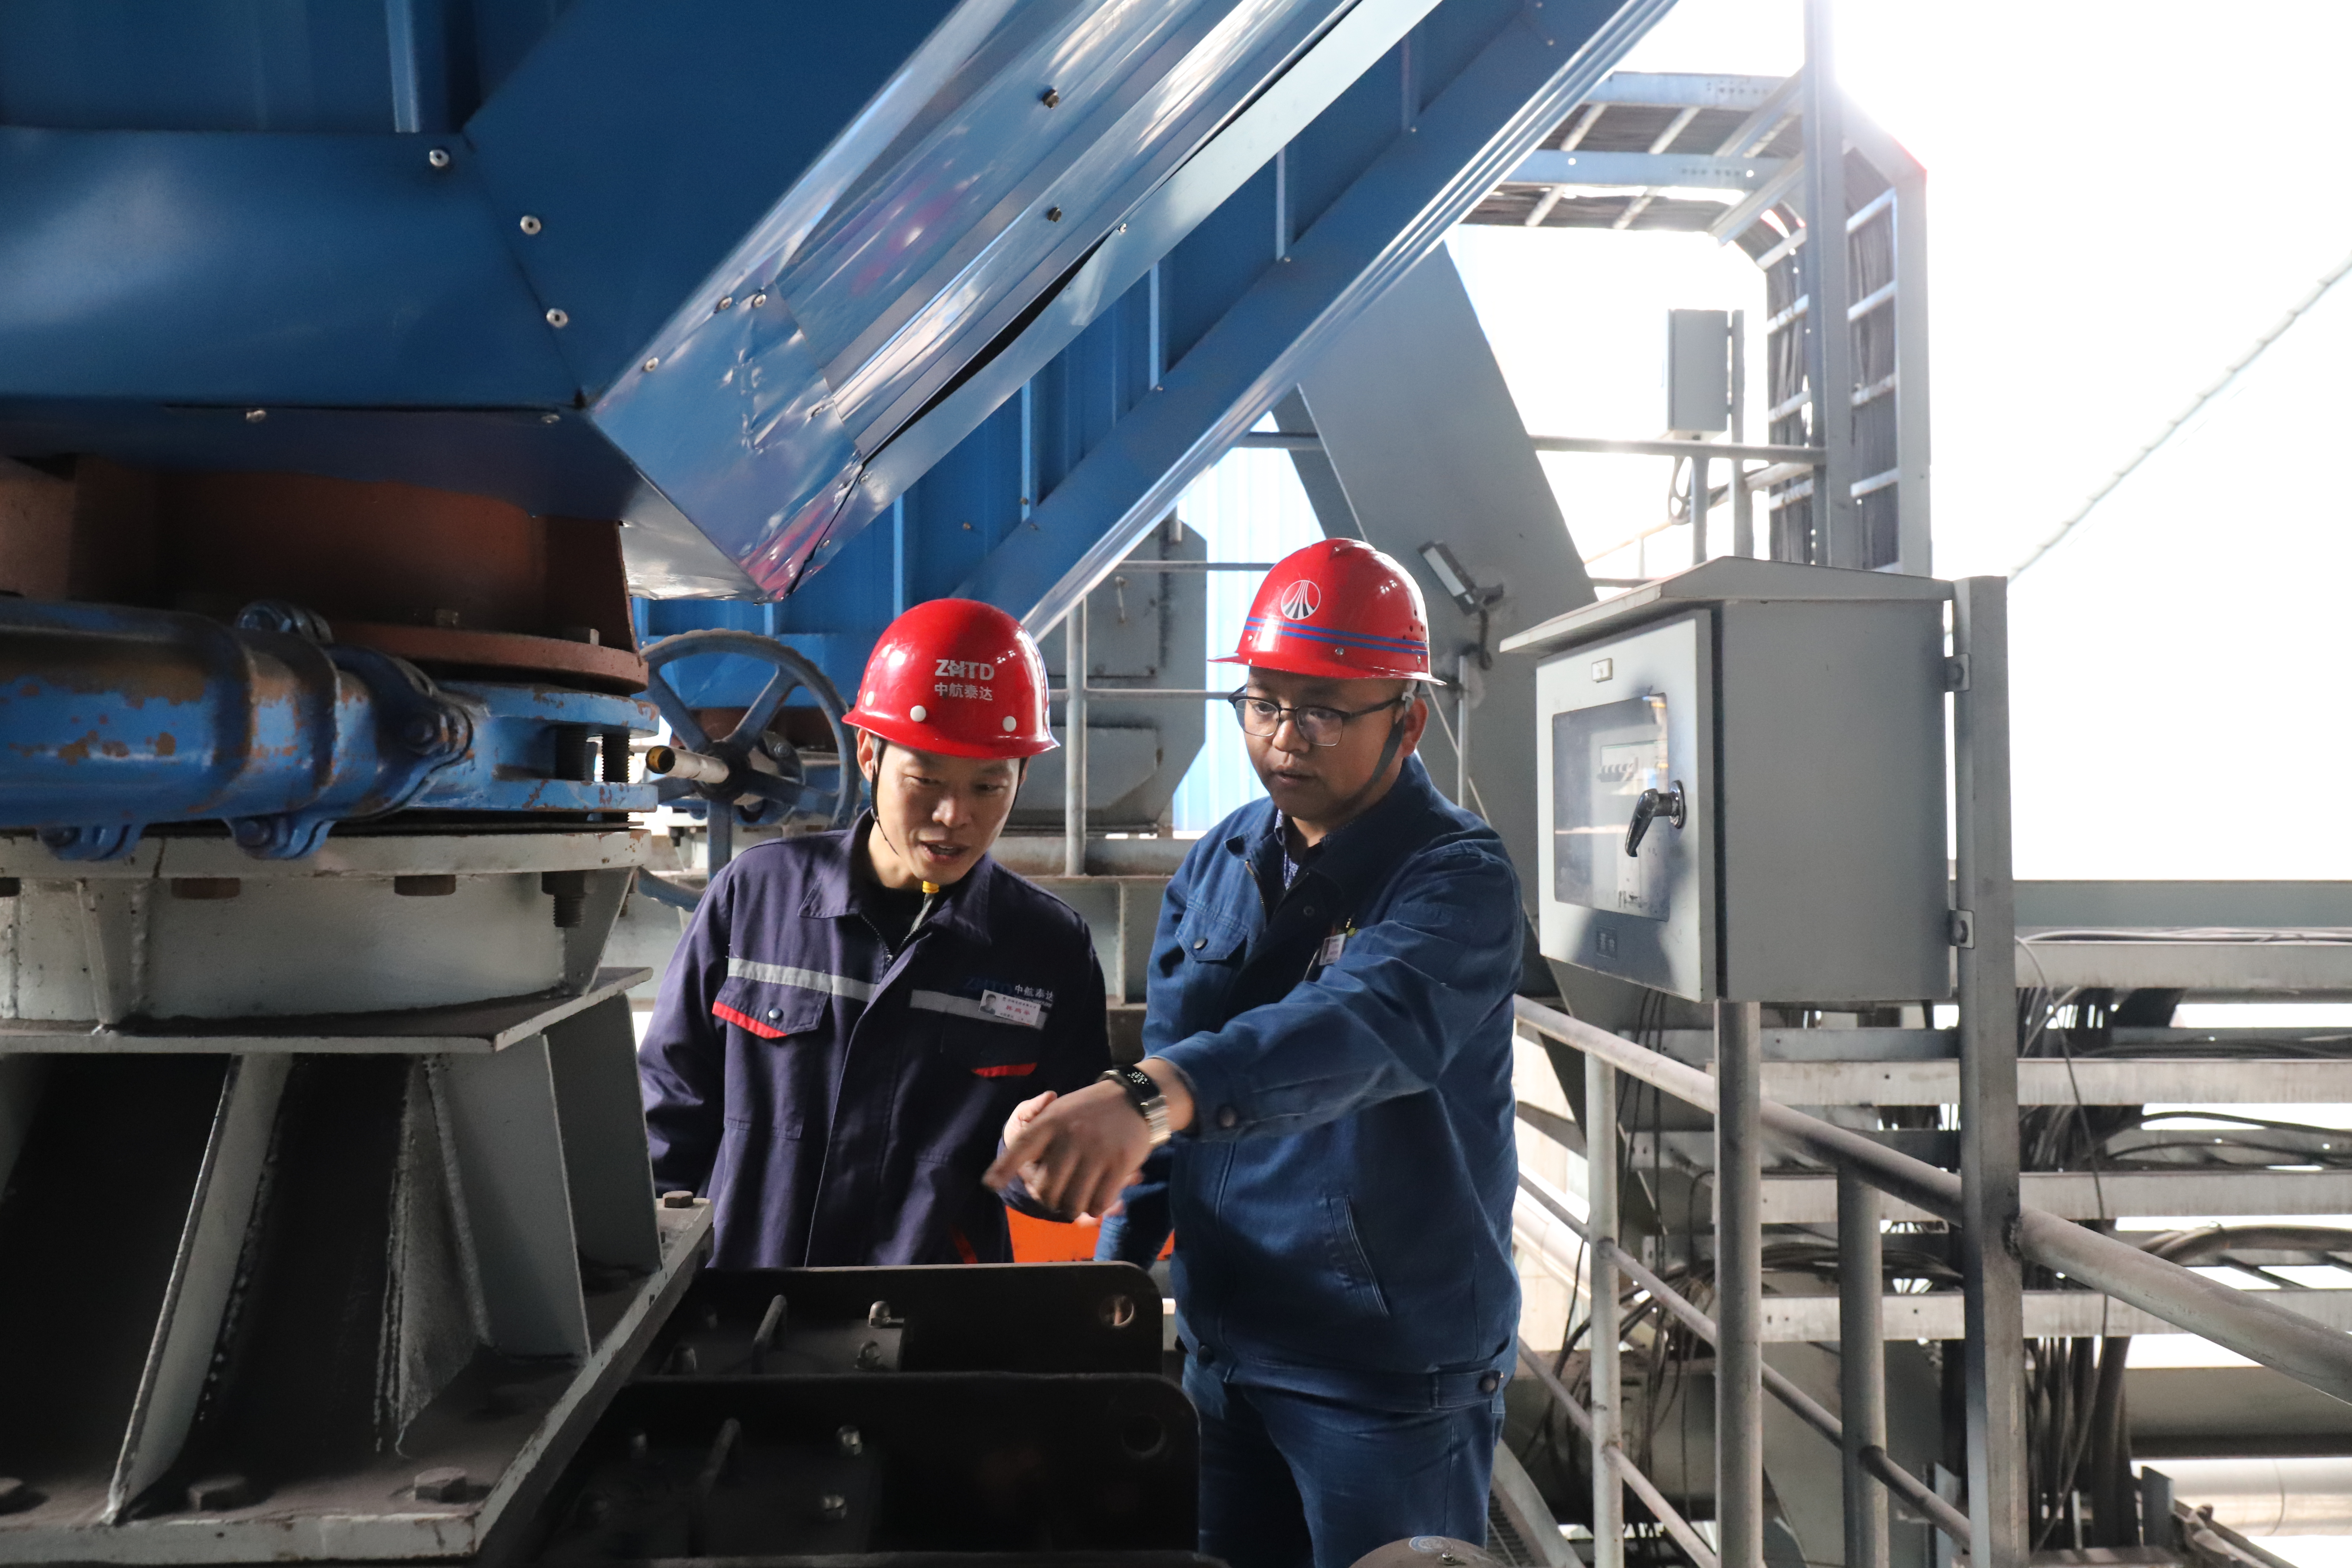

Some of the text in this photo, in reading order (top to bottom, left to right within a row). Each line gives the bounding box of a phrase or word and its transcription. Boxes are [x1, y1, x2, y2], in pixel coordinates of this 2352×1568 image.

[935, 659, 994, 680] ZHTD
[935, 682, 993, 701] 中航泰达
[1015, 984, 1054, 1001] 中航泰达
